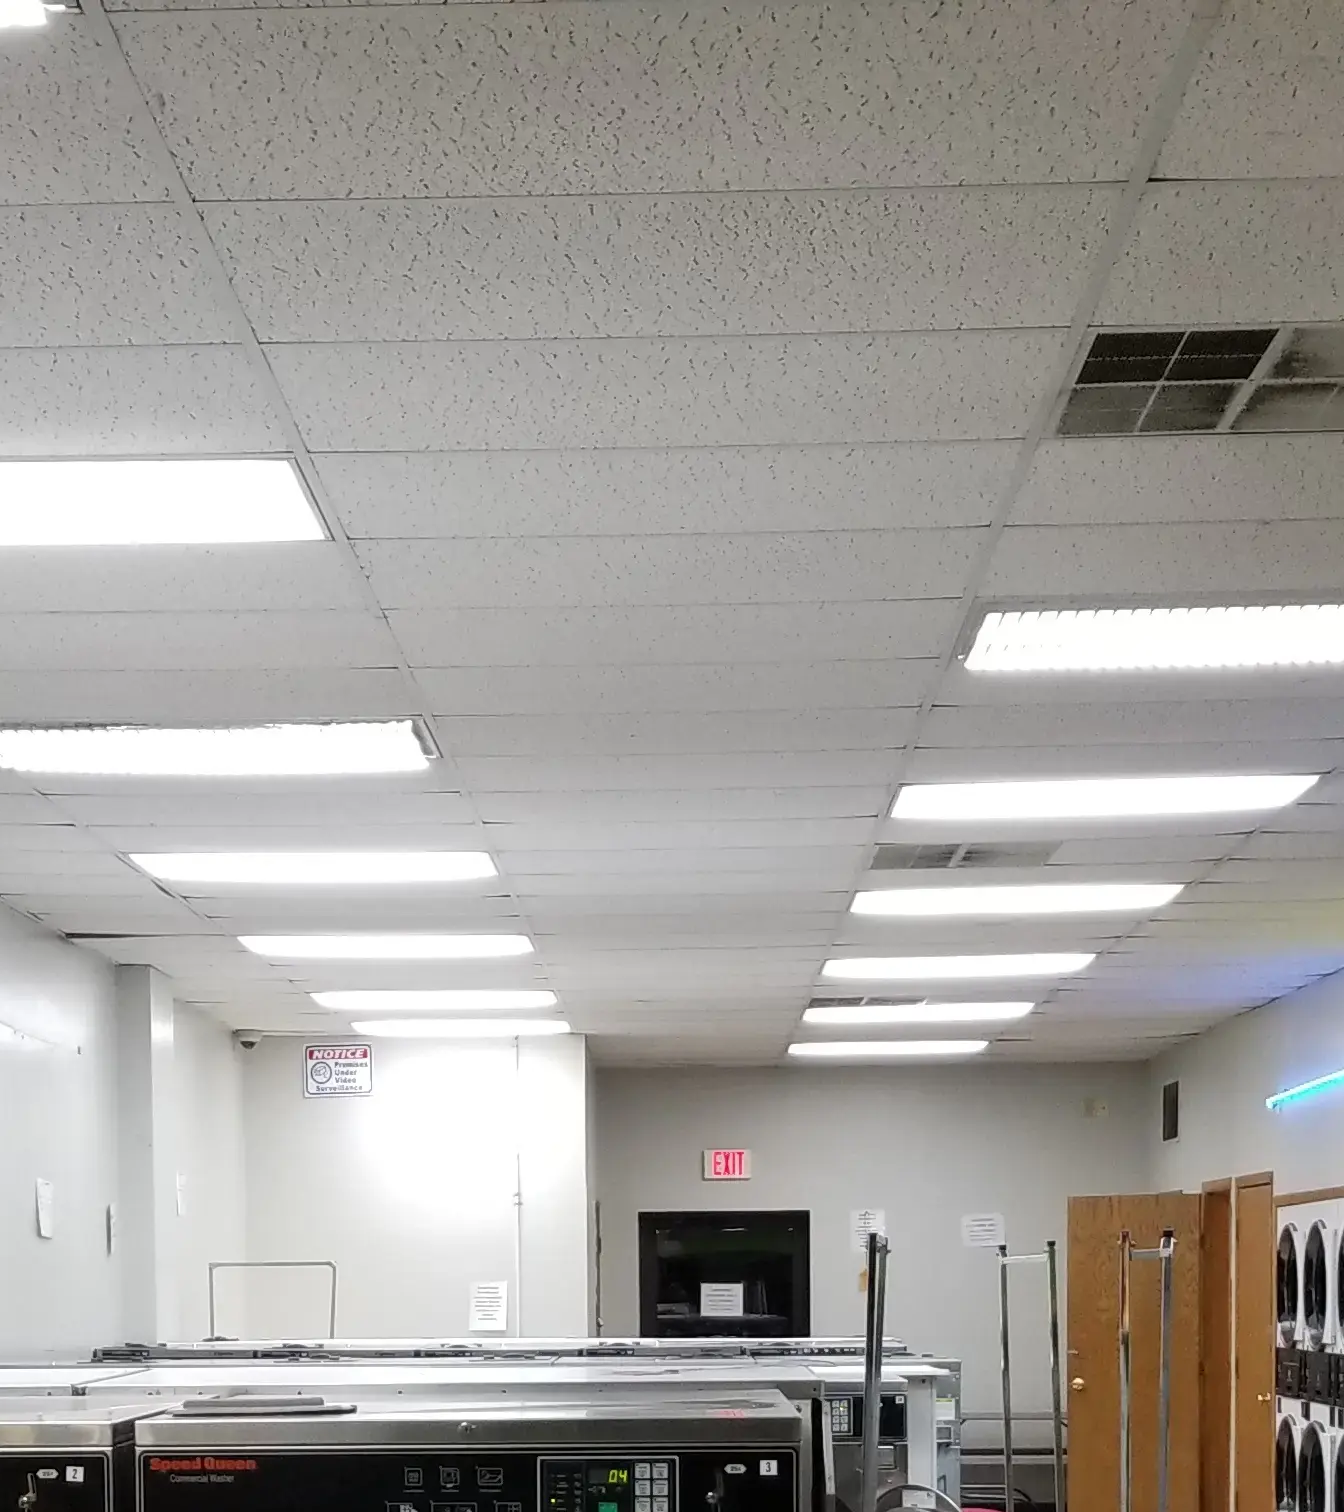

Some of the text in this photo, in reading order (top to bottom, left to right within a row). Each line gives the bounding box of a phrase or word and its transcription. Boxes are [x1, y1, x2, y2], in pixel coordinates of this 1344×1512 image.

[312, 1049, 365, 1060] NOTICE
[713, 1151, 745, 1176] EXIT
[150, 1456, 258, 1473] Speed Queen
[765, 1461, 772, 1473] 3
[72, 1468, 78, 1480] 2
[608, 1469, 628, 1483] 04
